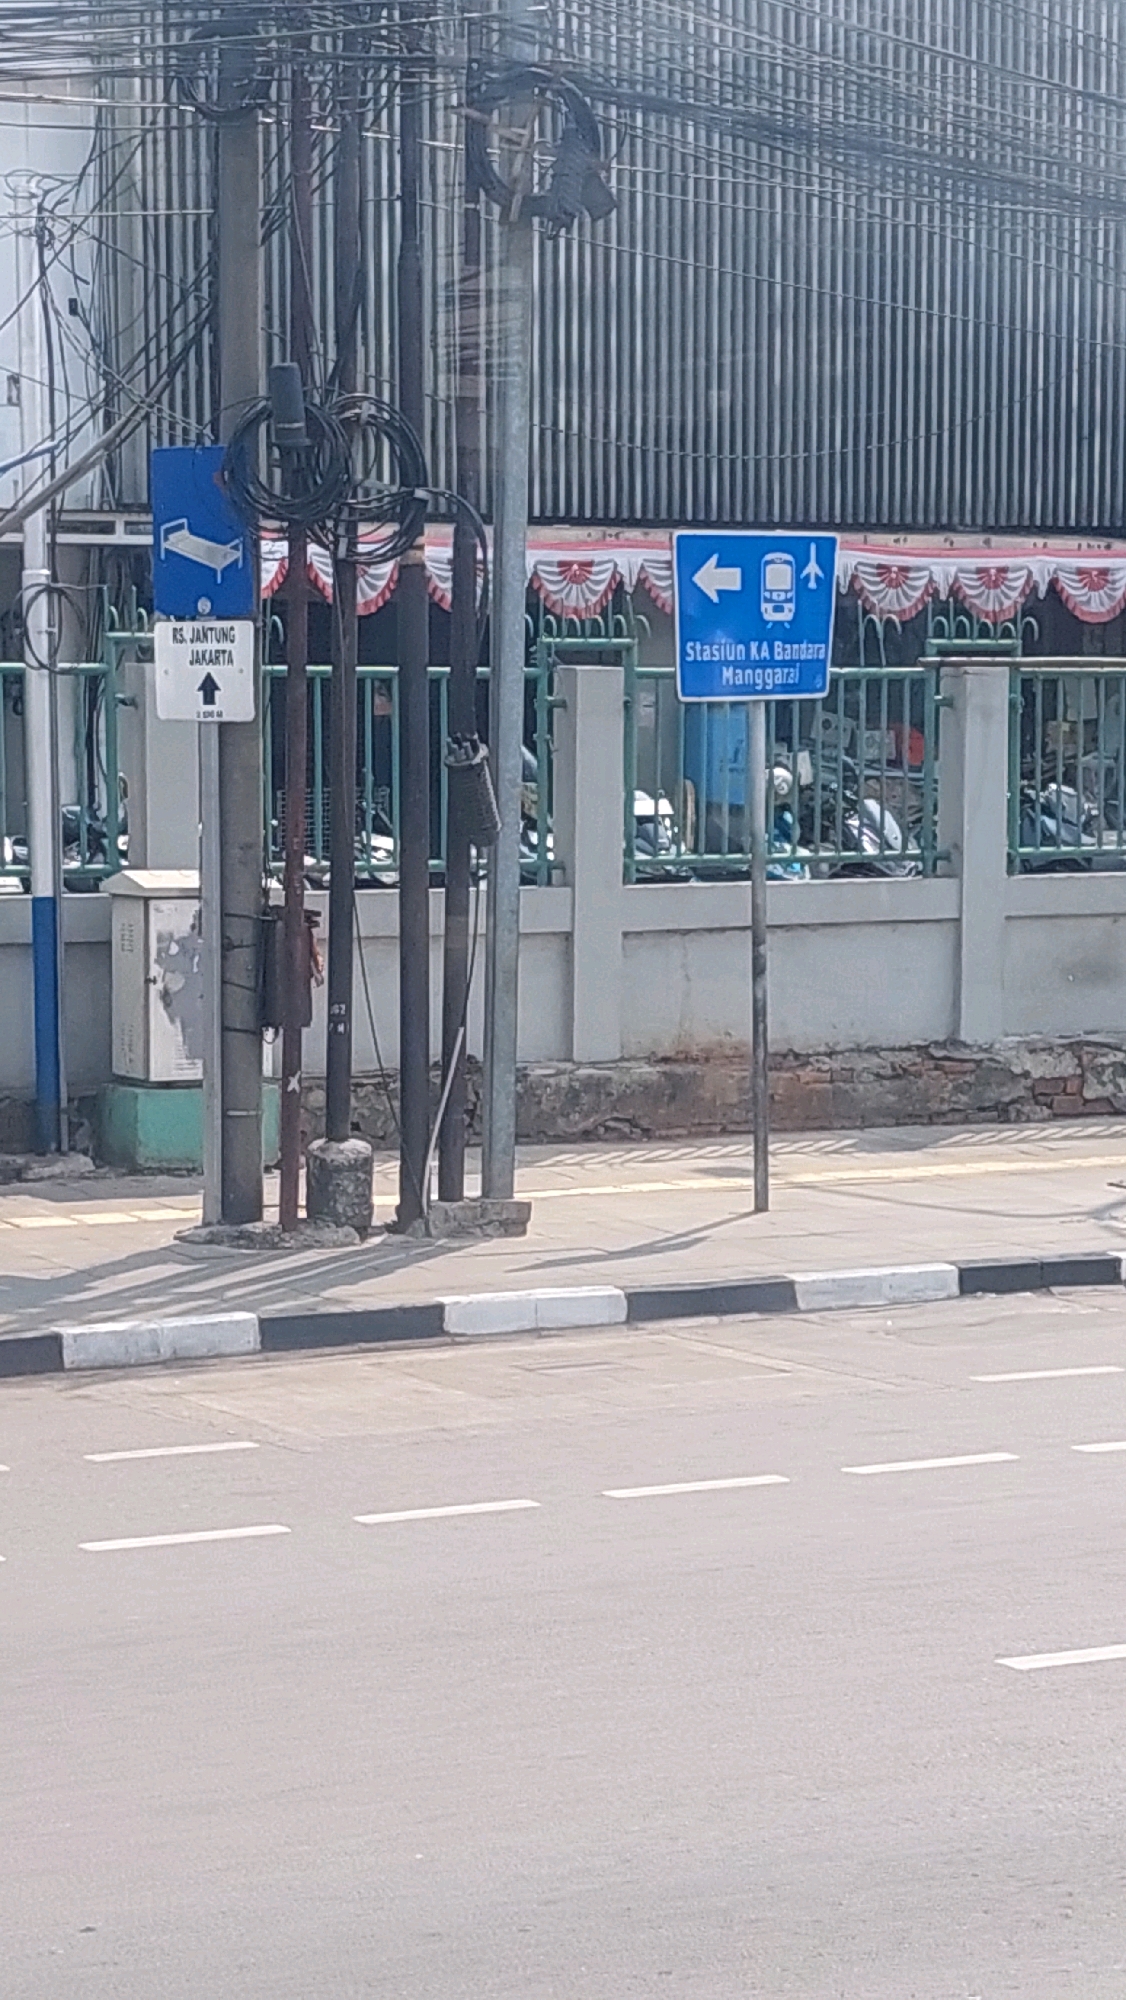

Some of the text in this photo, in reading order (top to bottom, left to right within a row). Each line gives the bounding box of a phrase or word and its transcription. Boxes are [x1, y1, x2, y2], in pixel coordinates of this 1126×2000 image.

[189, 625, 236, 645] JANTUNG
[189, 648, 235, 667] JAKARTA
[685, 639, 826, 662] Stasiun KA Bandara
[722, 662, 801, 690] Manggarai
